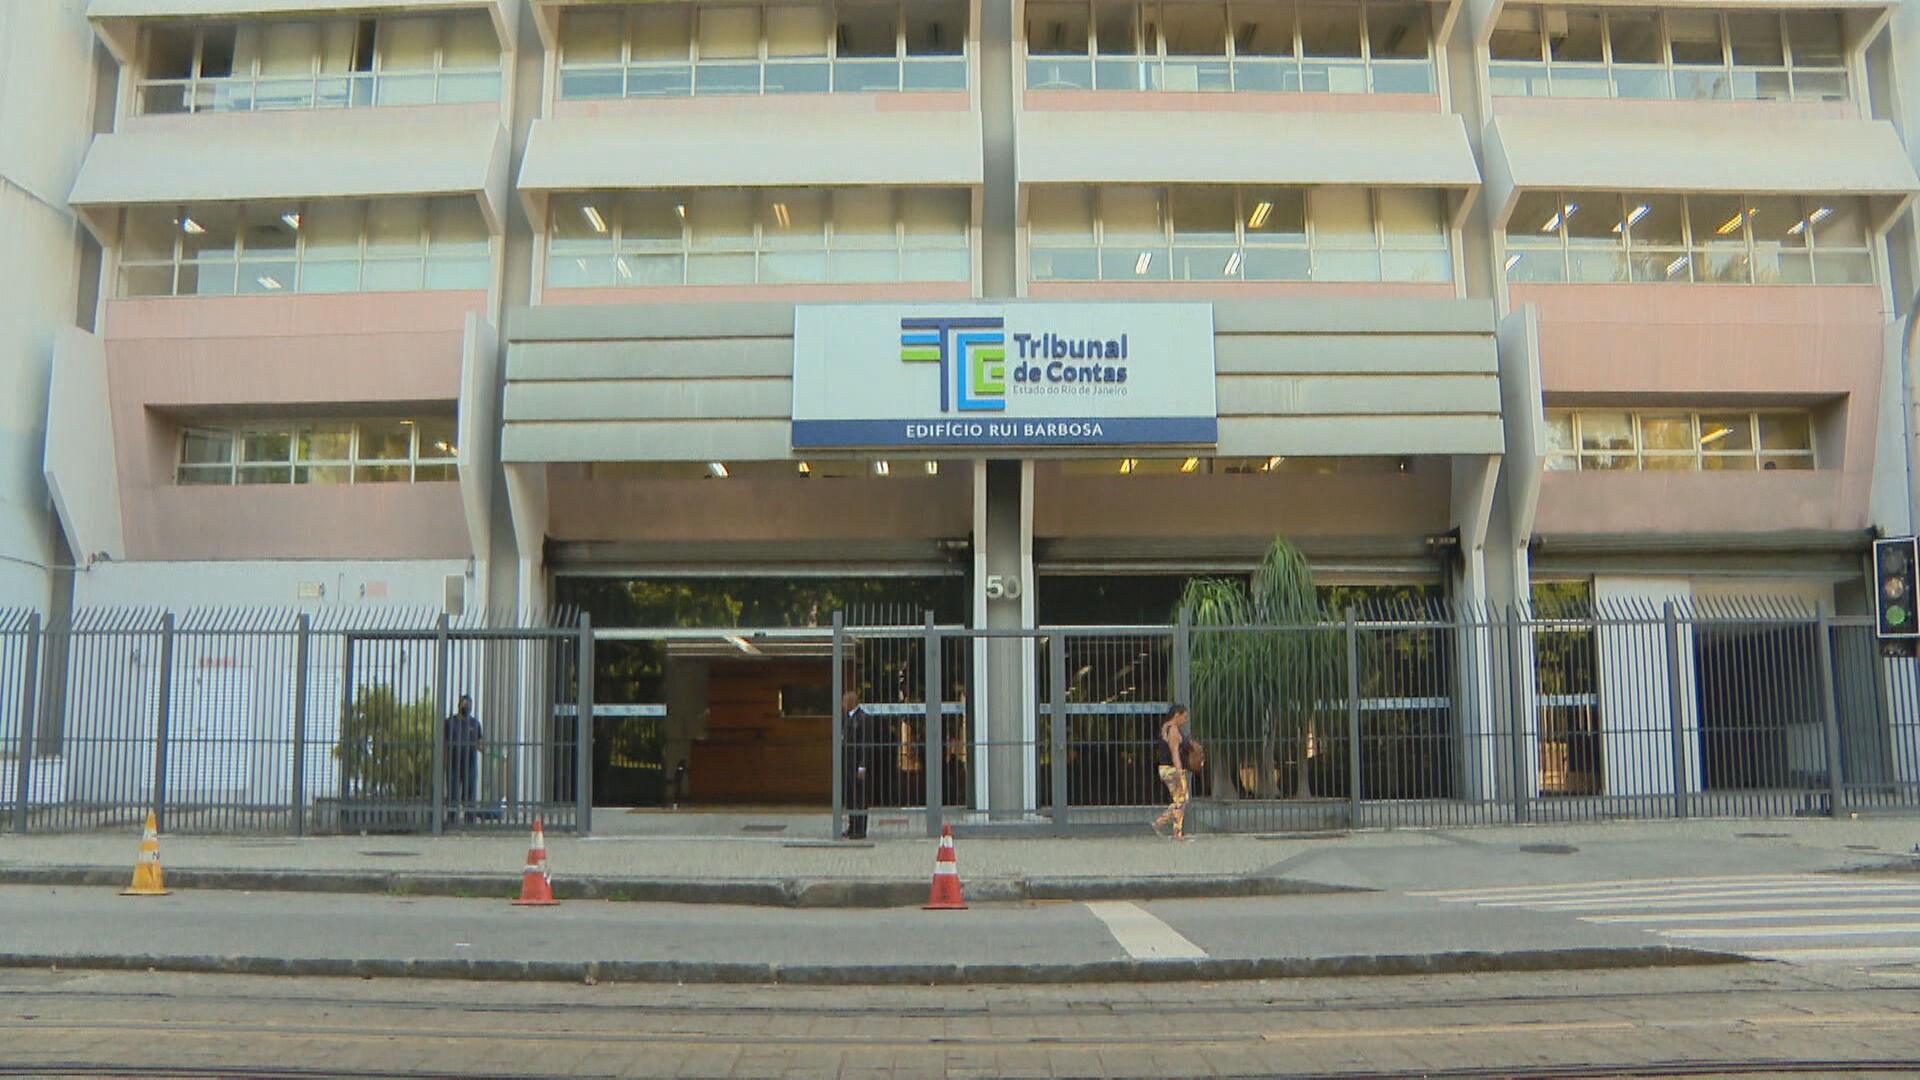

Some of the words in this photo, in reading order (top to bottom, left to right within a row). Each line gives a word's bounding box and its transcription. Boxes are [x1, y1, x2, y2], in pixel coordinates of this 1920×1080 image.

[1013, 333, 1127, 359] Tribunal
[1014, 361, 1042, 383] de
[1046, 361, 1127, 383] Contas
[1013, 385, 1046, 395] Estado
[1047, 385, 1060, 395] do
[1061, 385, 1077, 395] Rio
[1079, 385, 1091, 395] de
[1092, 385, 1128, 396] Janeiro
[906, 422, 983, 438] EDIFÍCIO
[990, 423, 1018, 437] RUI
[1024, 422, 1104, 437] BARBOSA
[987, 575, 1022, 599] 50
